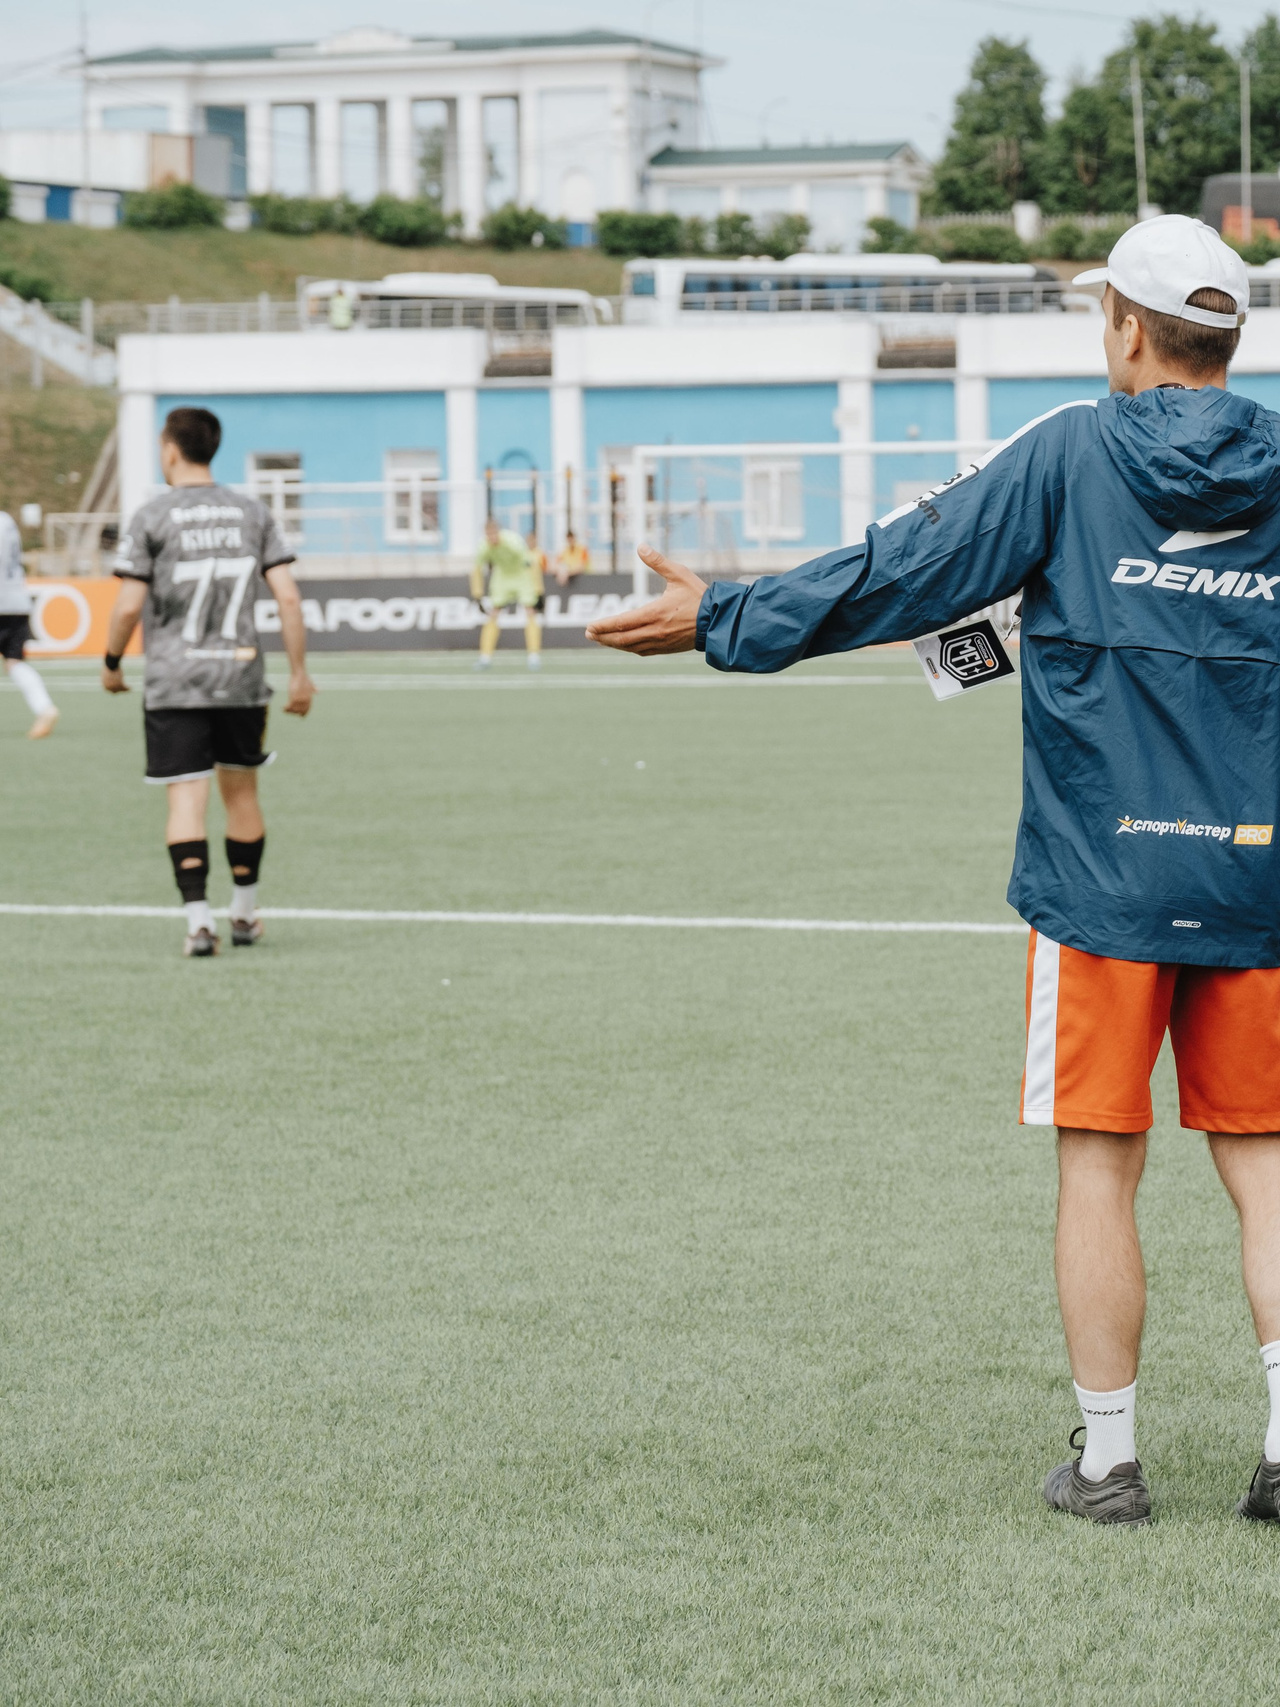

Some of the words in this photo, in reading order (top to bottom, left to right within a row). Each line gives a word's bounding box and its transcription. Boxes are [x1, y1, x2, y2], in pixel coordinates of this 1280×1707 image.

[172, 555, 257, 642] 77
[947, 639, 983, 677] MFL
[1235, 827, 1271, 843] PRO
